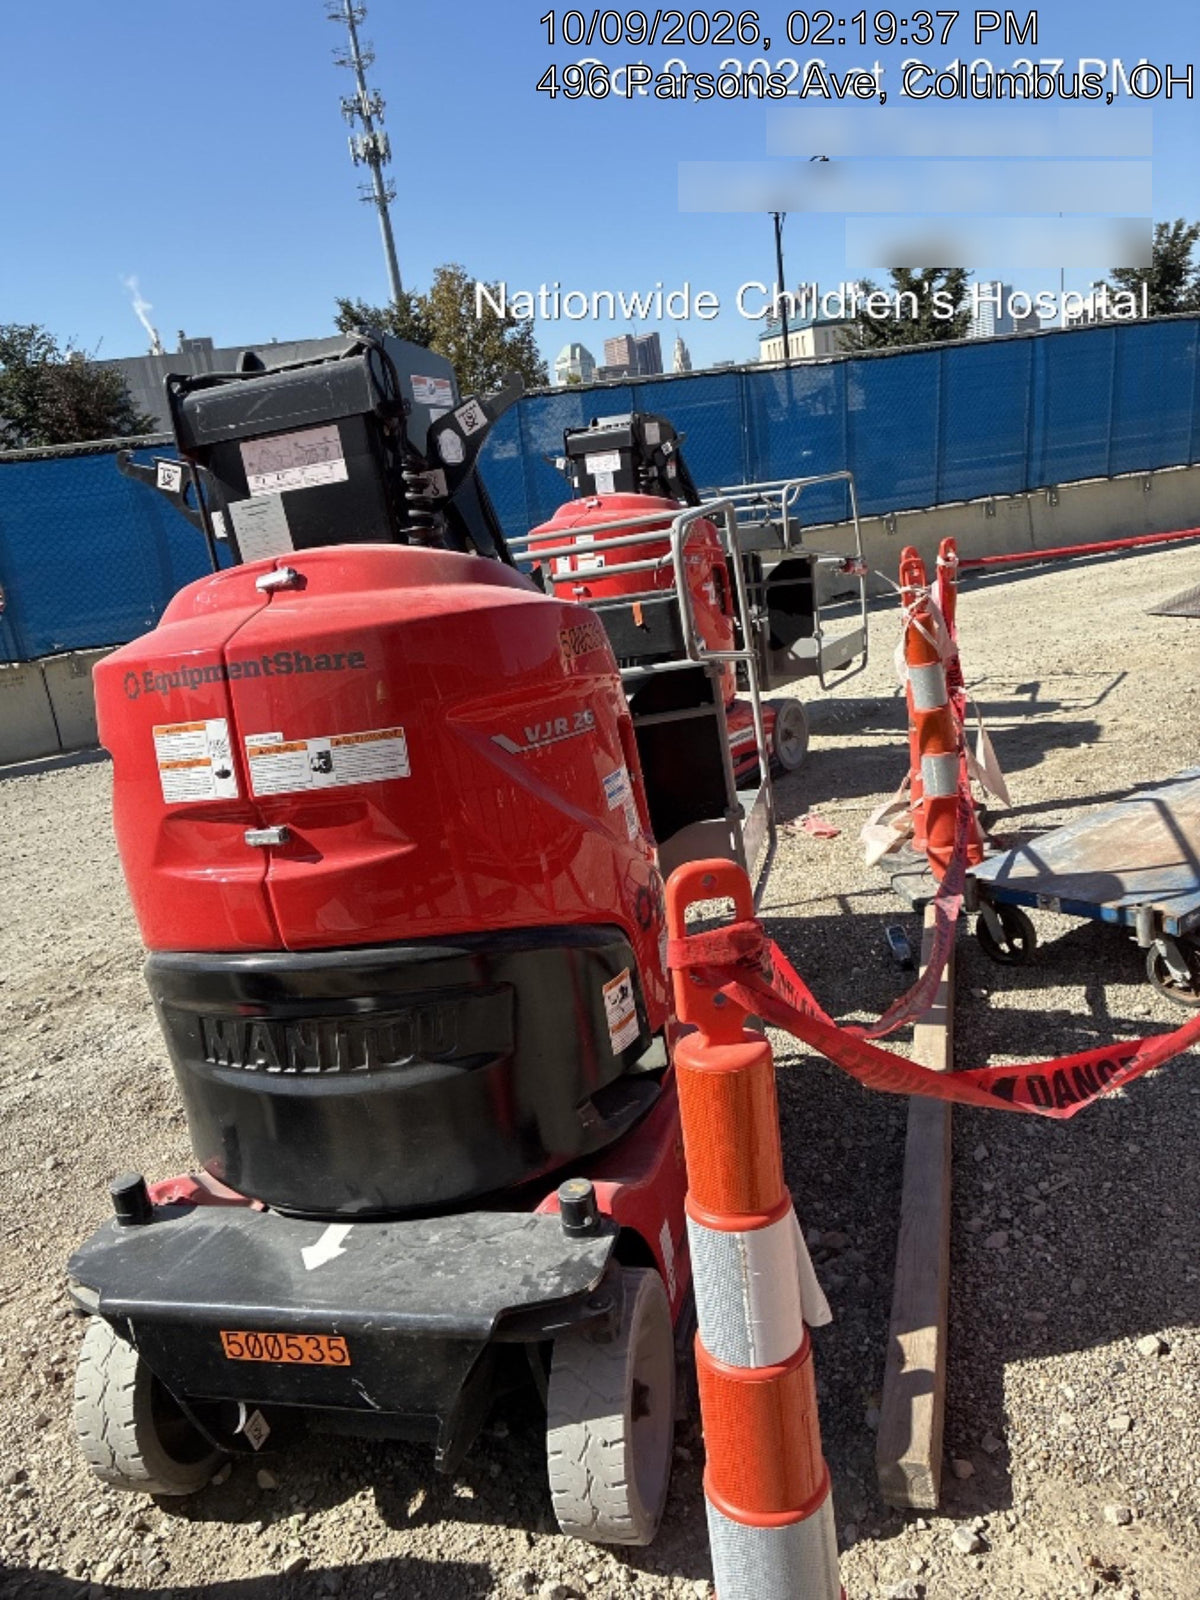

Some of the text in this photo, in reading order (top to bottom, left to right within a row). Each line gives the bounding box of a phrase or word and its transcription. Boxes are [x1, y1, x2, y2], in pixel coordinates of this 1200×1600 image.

[143, 651, 367, 695] EquipmentShare
[524, 709, 595, 742] VJR 26
[201, 1003, 457, 1073] MANITOU
[225, 1333, 347, 1364] 500535
